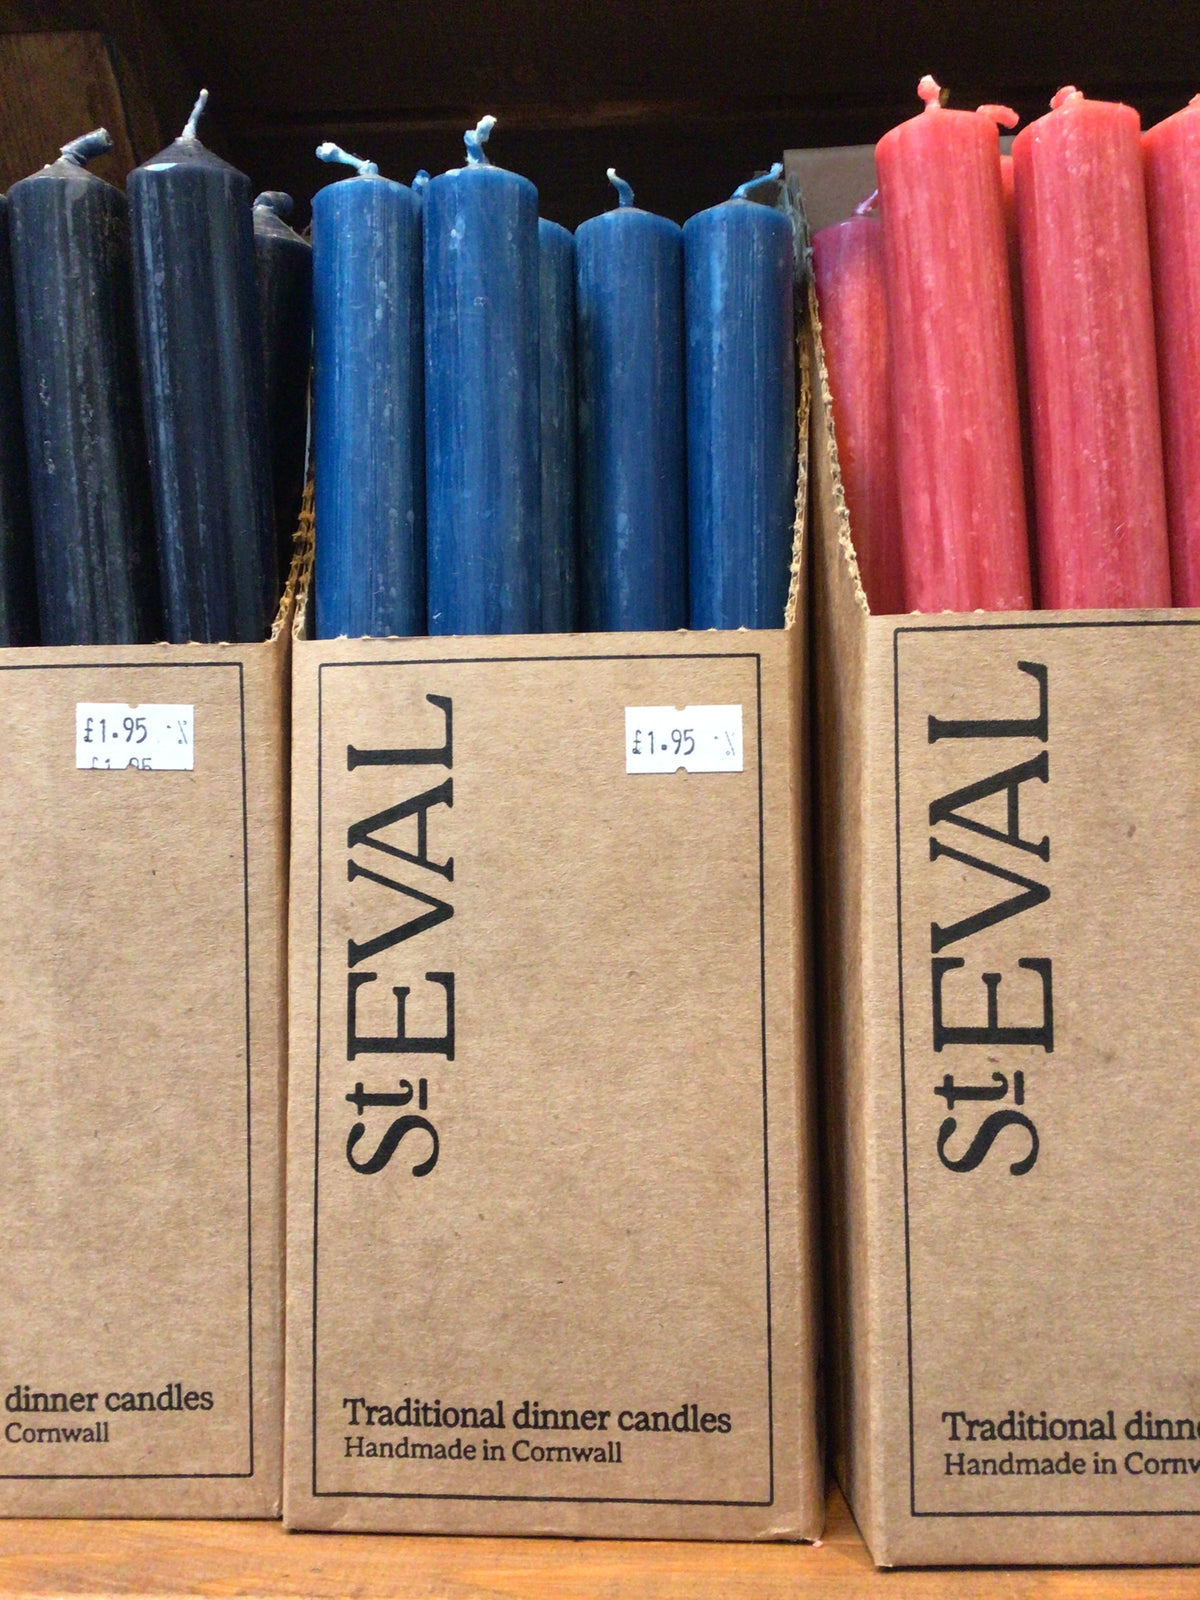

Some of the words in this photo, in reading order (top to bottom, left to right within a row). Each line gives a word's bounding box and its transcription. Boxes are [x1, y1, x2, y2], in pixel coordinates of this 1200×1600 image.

[83, 717, 148, 744] £1.95
[632, 729, 695, 756] £1.95
[928, 660, 1054, 1053] EVAL
[347, 693, 455, 1061] EVAL
[345, 1078, 440, 1177] St
[934, 1070, 1040, 1176] St
[5, 1385, 98, 1413] dinner
[105, 1383, 214, 1411] candles
[343, 1398, 503, 1429] Traditional
[513, 1402, 610, 1431] dinner
[618, 1404, 732, 1433] candles
[941, 1410, 1117, 1441] Traditional
[5, 1422, 110, 1443] Cornwall
[344, 1437, 476, 1460] Handmade
[482, 1440, 505, 1461] in
[512, 1440, 622, 1463] Cornwall
[944, 1452, 1087, 1476] Handmade
[1093, 1452, 1117, 1475] in
